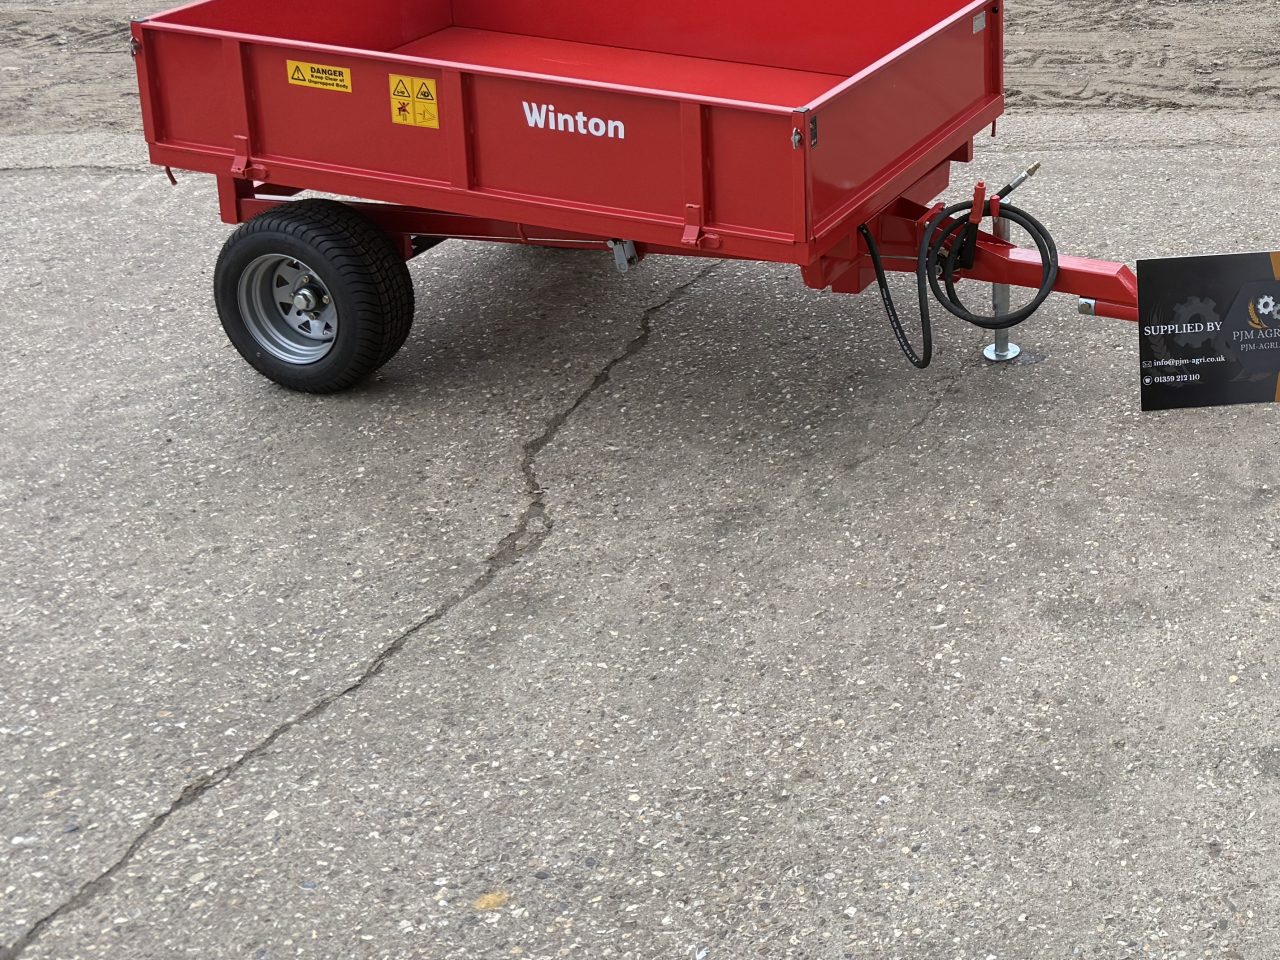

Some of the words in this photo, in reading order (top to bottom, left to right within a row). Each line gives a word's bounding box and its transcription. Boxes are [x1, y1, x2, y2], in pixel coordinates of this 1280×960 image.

[310, 66, 344, 77] DANGER
[522, 101, 625, 139] Winton
[1144, 322, 1204, 336] SUPPLIED
[1206, 322, 1222, 332] BY
[1233, 330, 1254, 342] PJM
[1154, 354, 1226, 366] info@pjm-agri.co.uk
